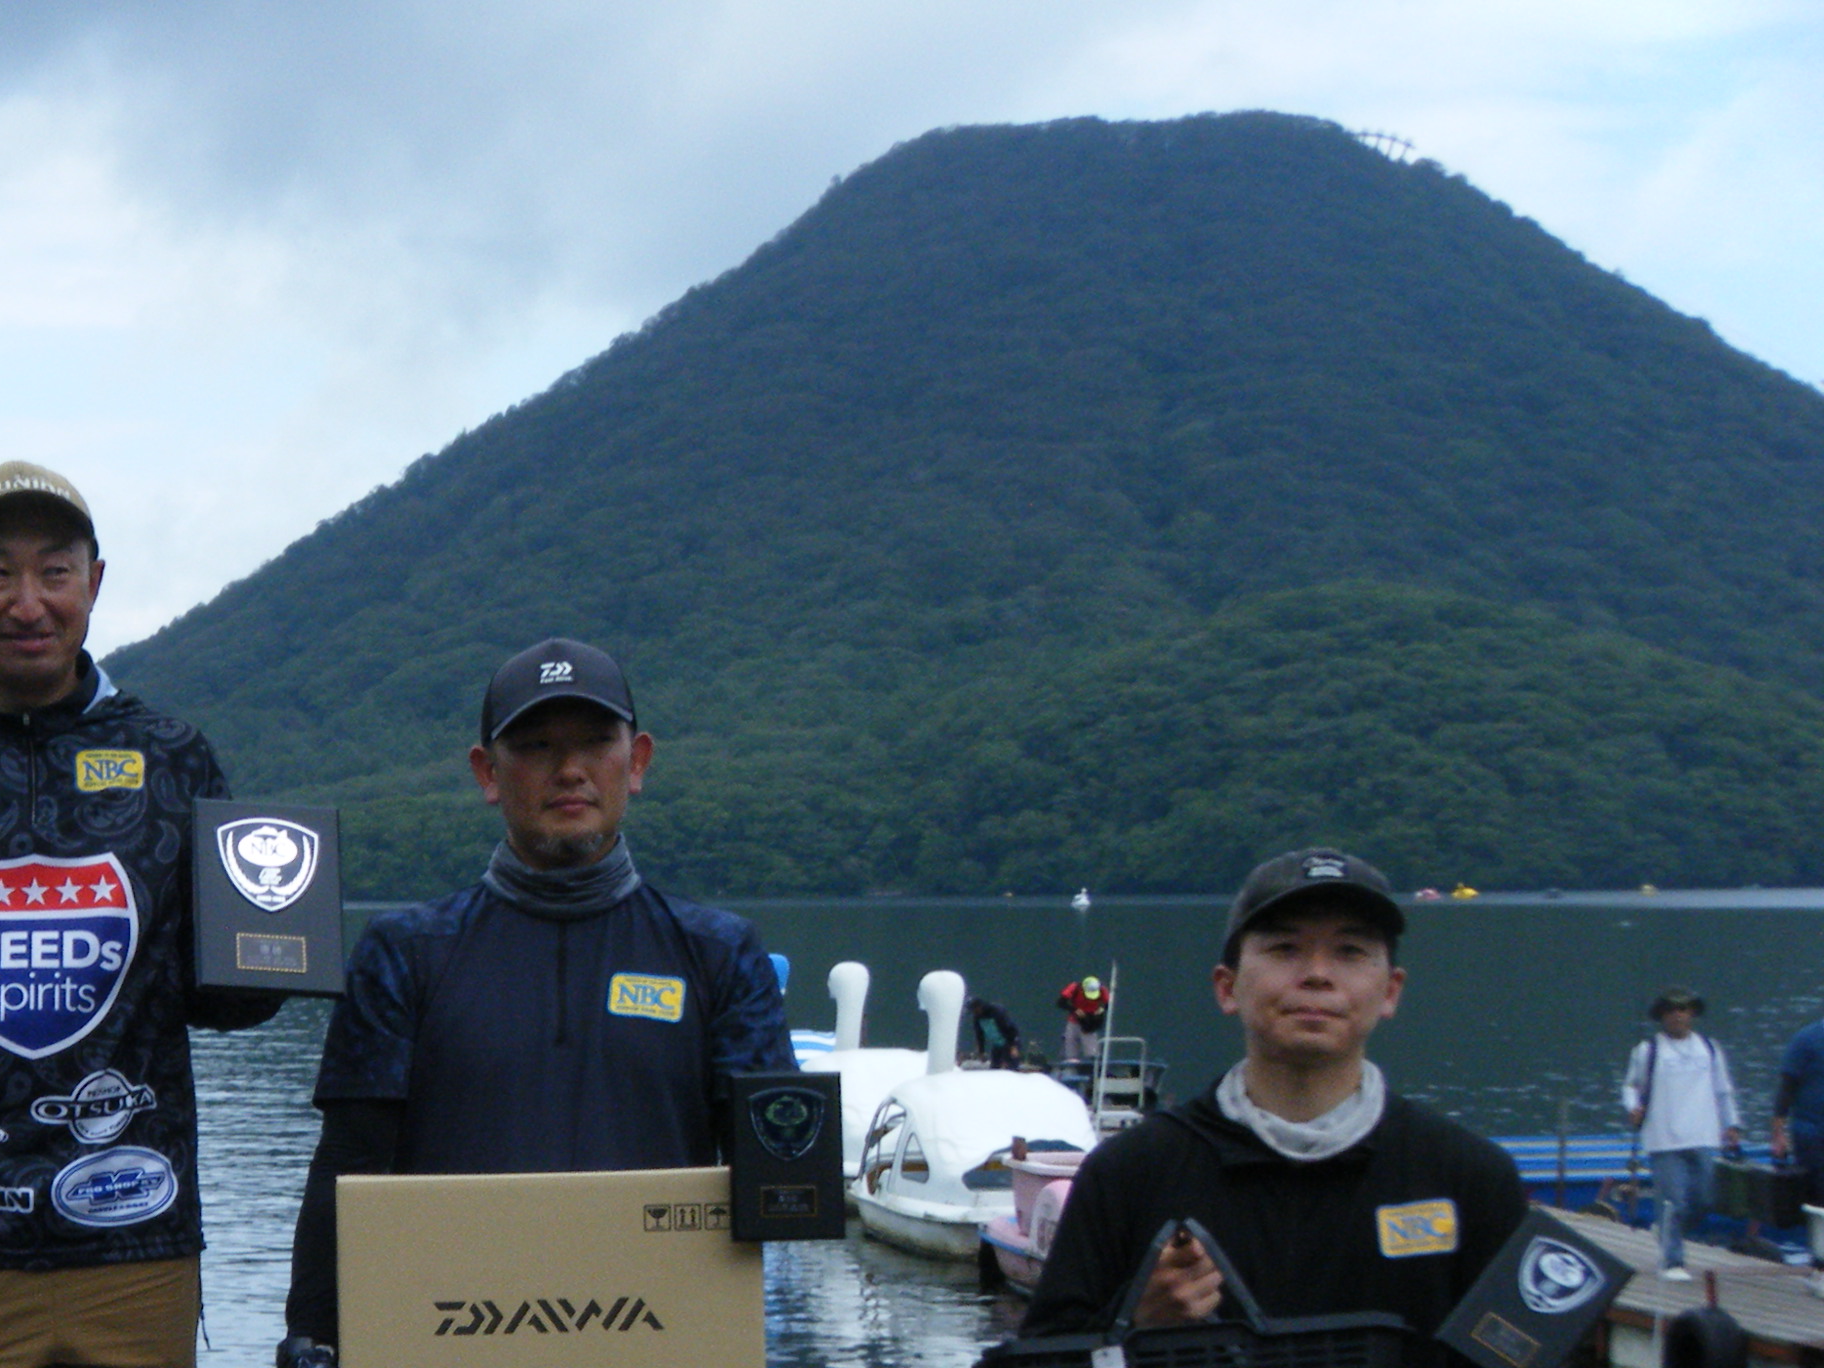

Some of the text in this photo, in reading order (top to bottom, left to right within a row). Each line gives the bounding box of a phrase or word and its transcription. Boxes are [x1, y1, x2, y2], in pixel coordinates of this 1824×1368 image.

[82, 759, 138, 780] NBC
[616, 984, 676, 1010] NBC
[37, 1089, 153, 1119] OTSUKA
[433, 1296, 665, 1336] DAIWA
